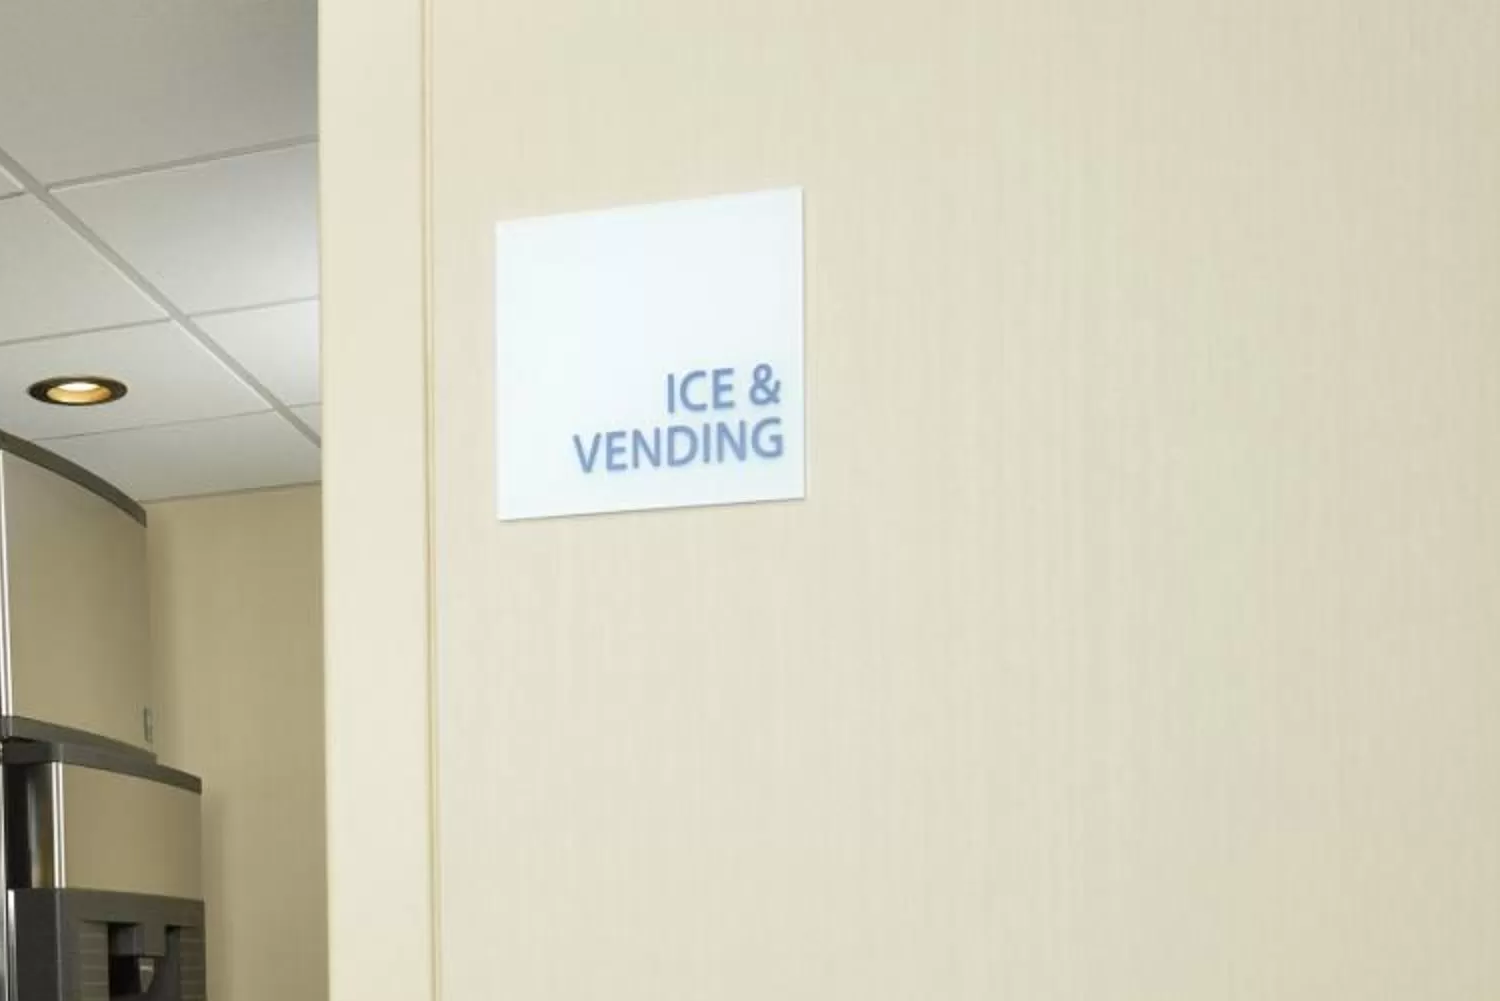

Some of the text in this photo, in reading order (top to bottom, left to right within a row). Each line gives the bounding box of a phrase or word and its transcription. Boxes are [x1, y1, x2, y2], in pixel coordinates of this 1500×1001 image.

[665, 362, 783, 415] ICE &
[571, 416, 785, 475] VENDING
